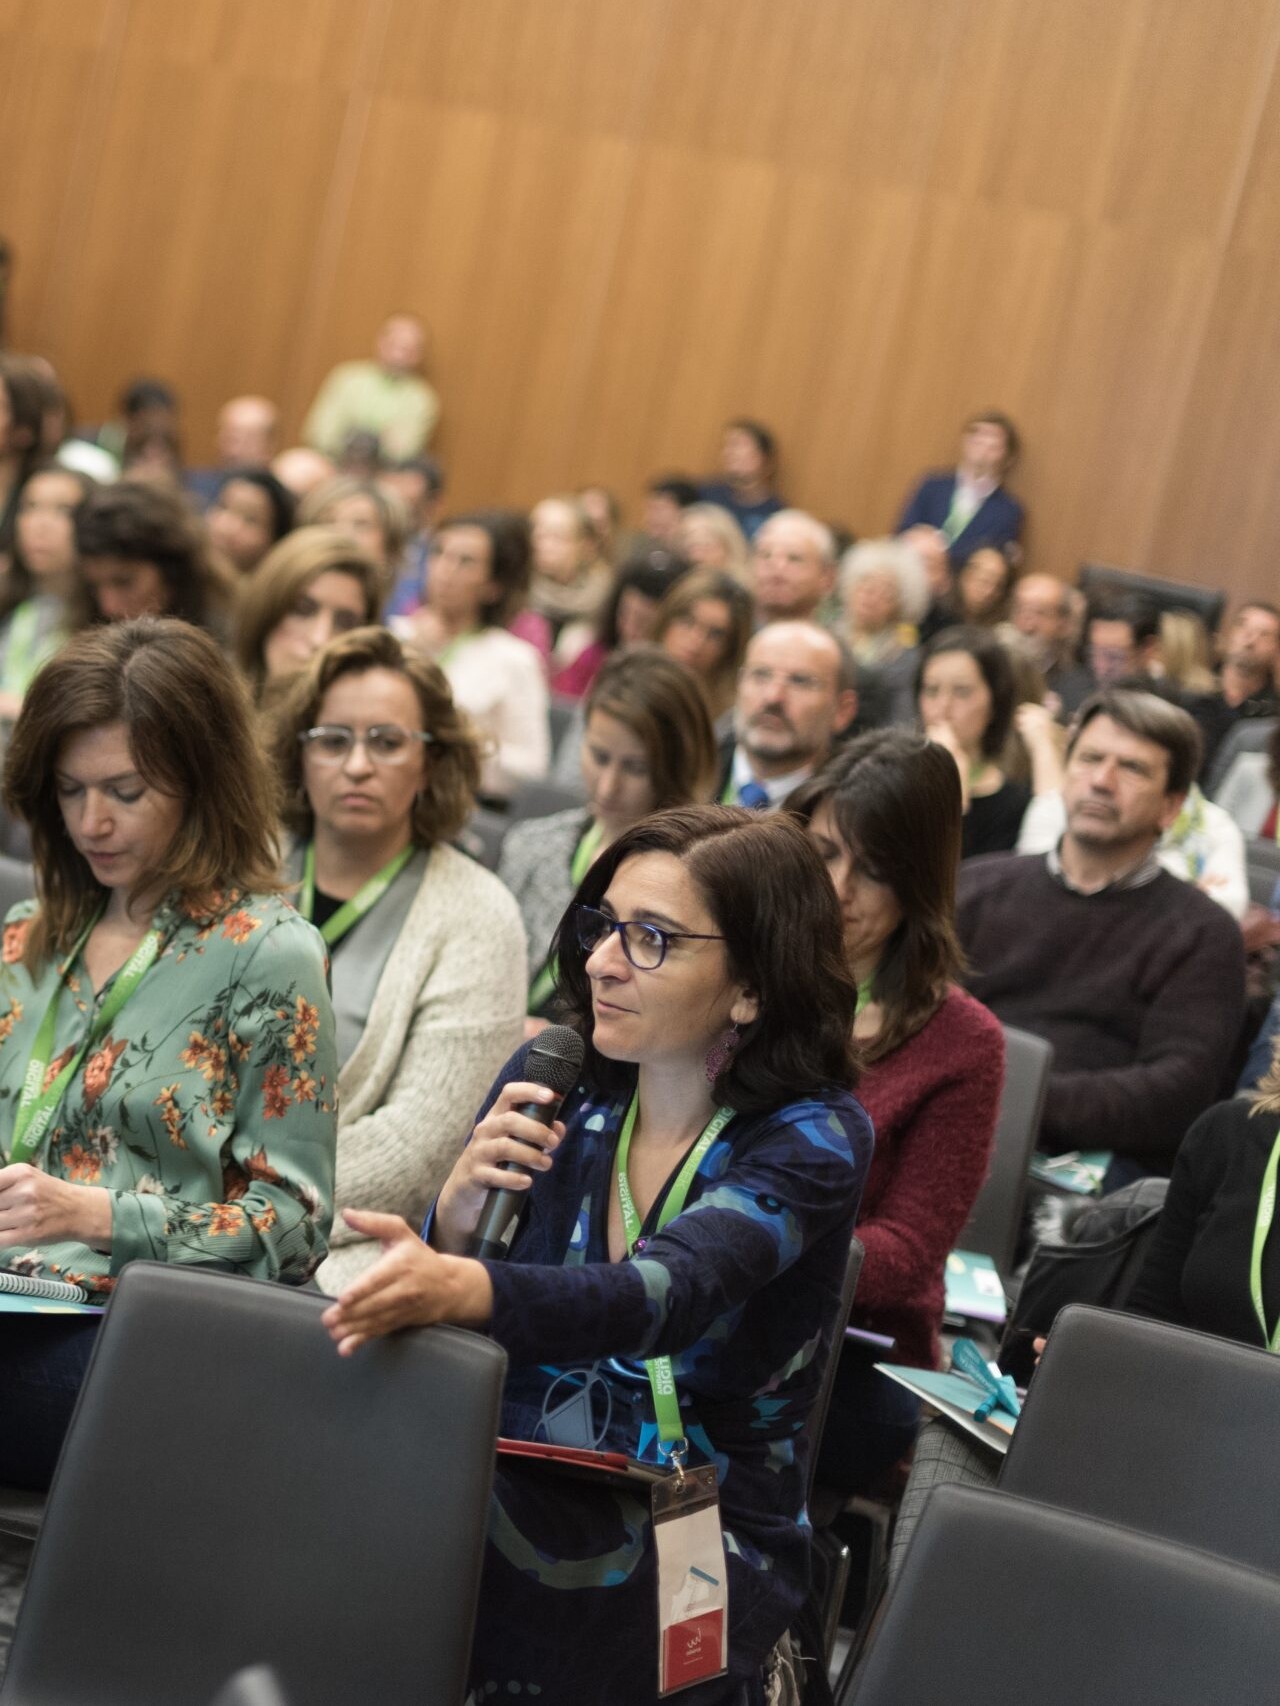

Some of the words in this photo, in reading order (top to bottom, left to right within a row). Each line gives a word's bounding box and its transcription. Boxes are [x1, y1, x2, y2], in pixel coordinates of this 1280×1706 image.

[21, 1059, 40, 1108] DIGITAL
[24, 1105, 55, 1148] DIGITAL
[695, 1106, 733, 1153] DIGITAL
[618, 1172, 634, 1229] DIGITAL
[660, 1355, 673, 1395] DIGIT
